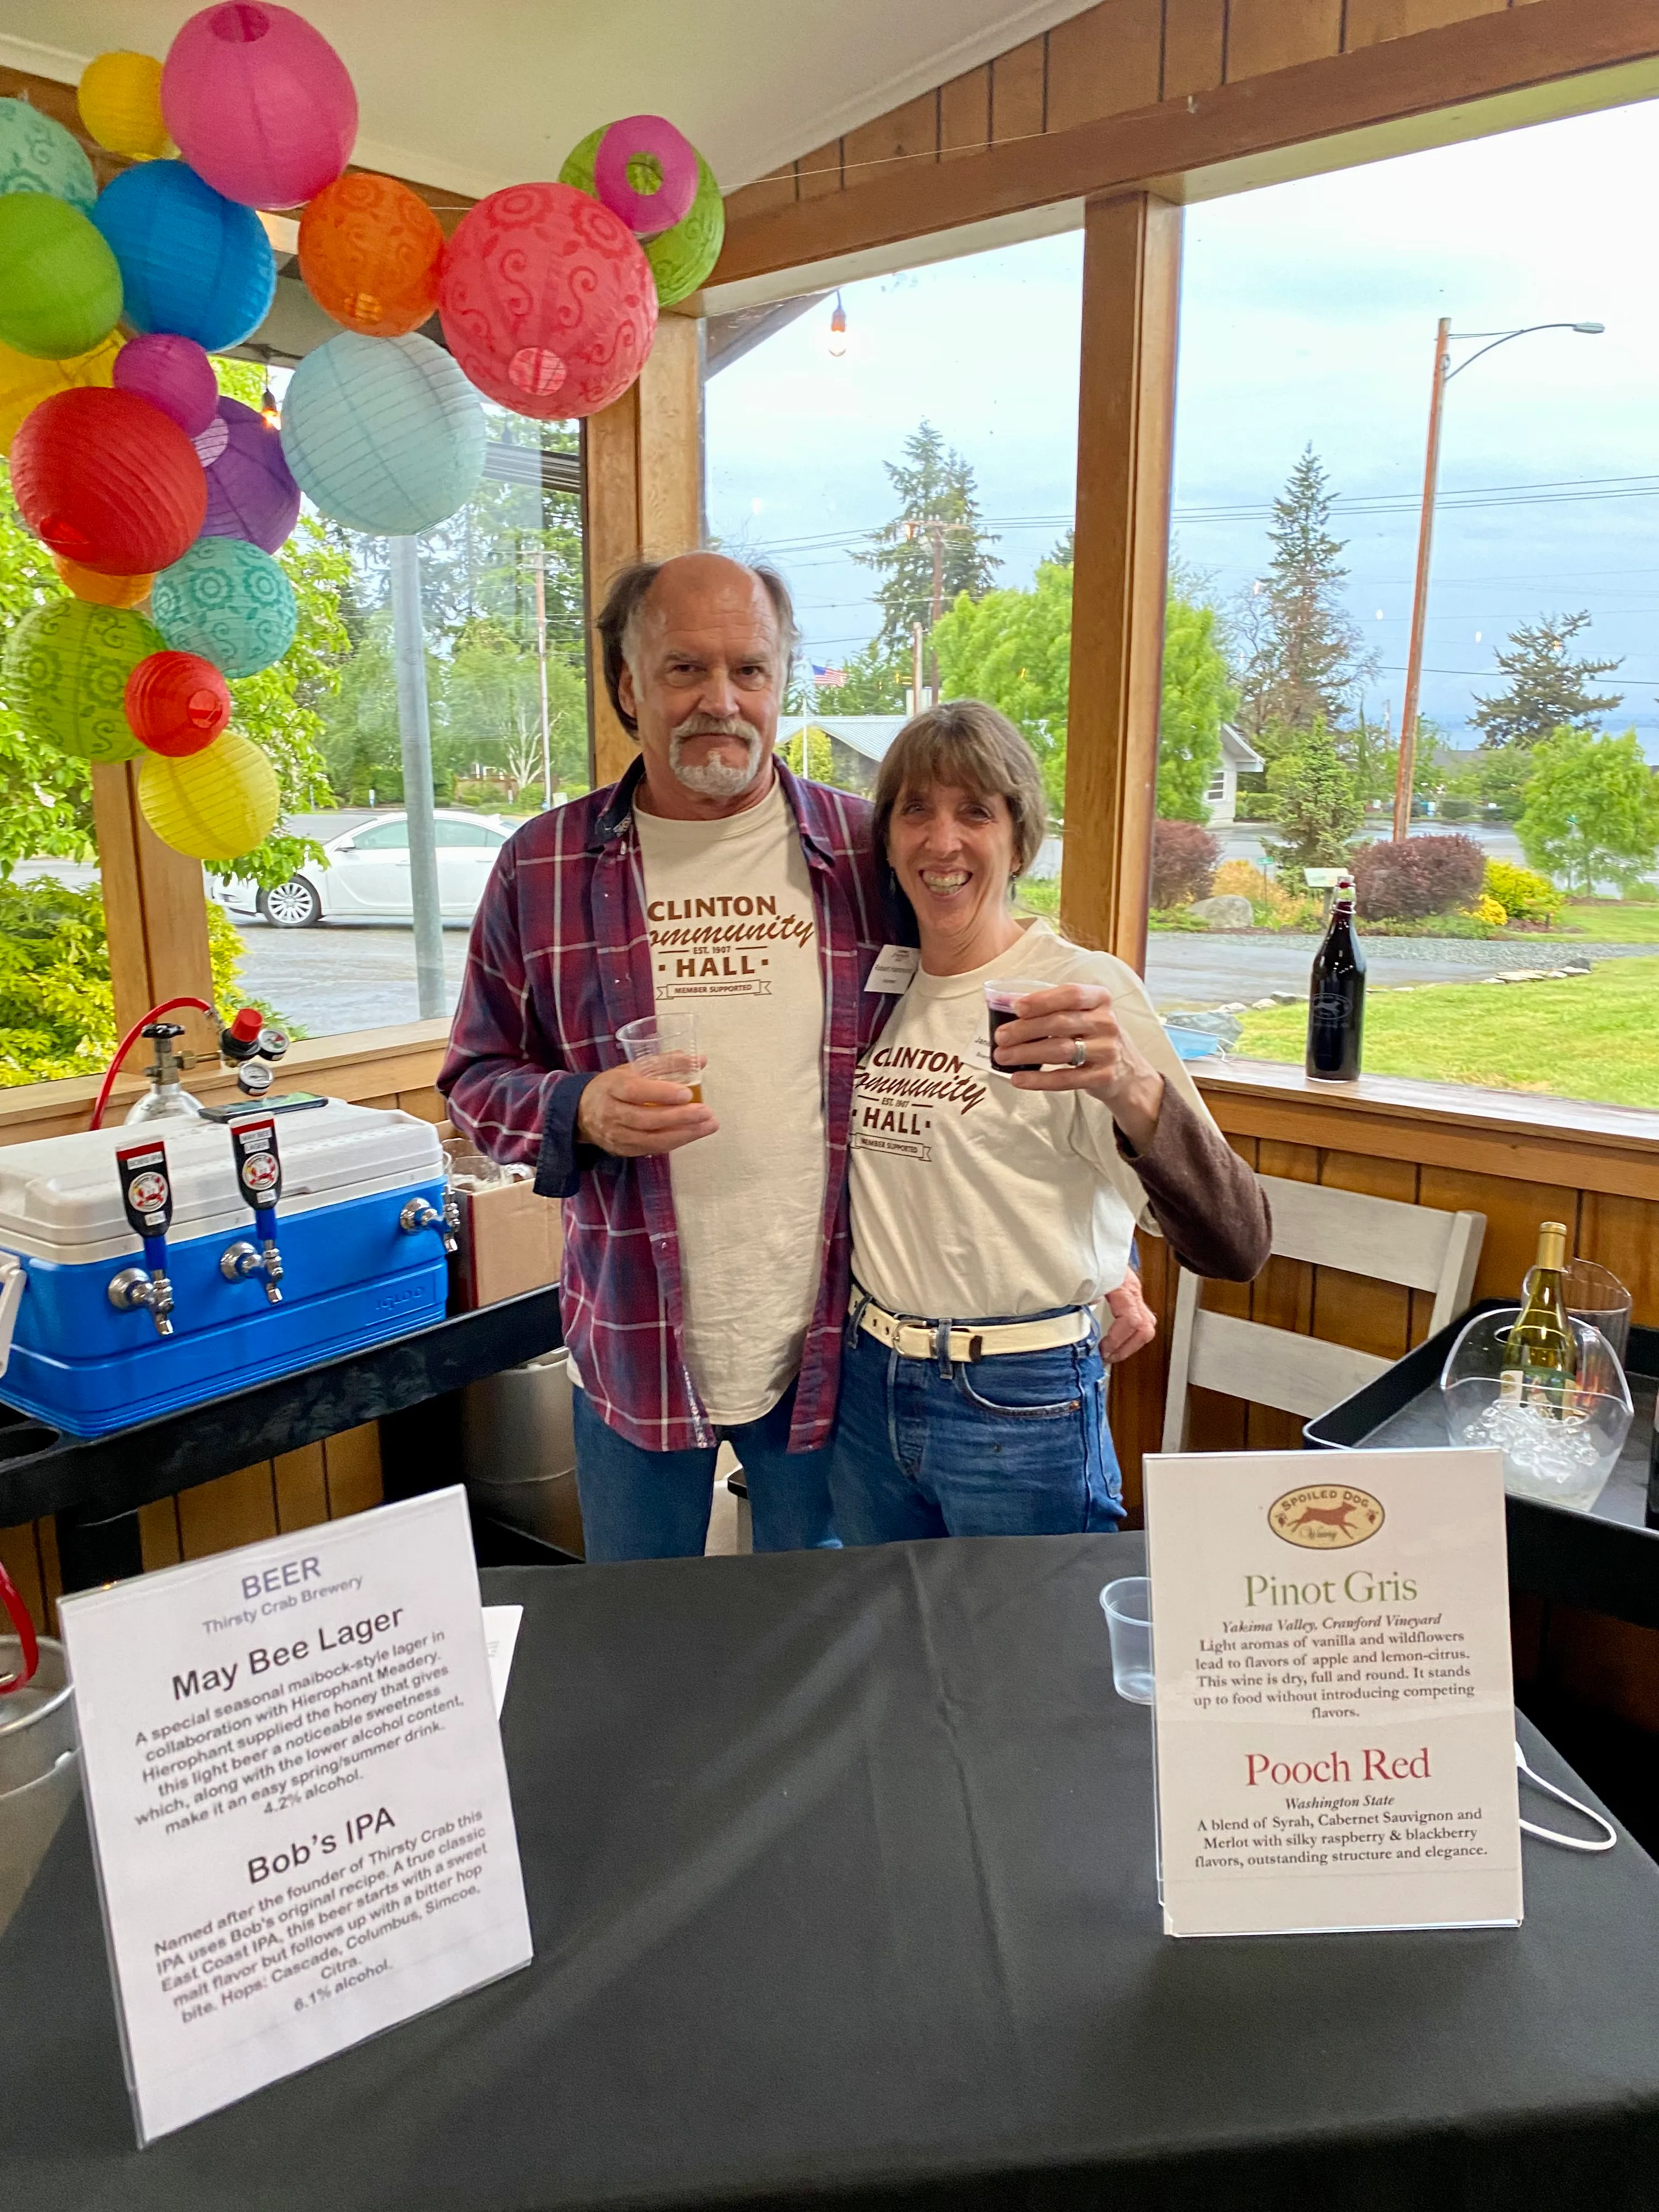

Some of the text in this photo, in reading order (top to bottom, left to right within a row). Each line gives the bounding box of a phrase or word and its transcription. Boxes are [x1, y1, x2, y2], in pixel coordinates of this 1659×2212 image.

[647, 895, 777, 922] CLINTON
[650, 913, 815, 949] ommunity
[713, 946, 732, 954] 1907
[676, 956, 755, 978] HALL
[709, 984, 753, 993] SUPPORTED
[873, 1047, 964, 1074] CLINTON
[854, 1066, 986, 1115] ommunity
[881, 1097, 894, 1106] EST.
[862, 1107, 921, 1136] HALL
[861, 1138, 918, 1153] MEMBER SUPPORTED
[375, 1286, 425, 1310] IGLOO
[1281, 1490, 1369, 1511] SPOILED DOG
[240, 1556, 321, 1601] BEER
[1244, 1570, 1418, 1607] Pinot Gris
[201, 1576, 363, 1635] Thirsty Crab Brewery
[1222, 1612, 1443, 1634] Yakima Valley, Crawford Vineyard
[171, 1607, 404, 1701] May Bee Lager
[1199, 1630, 1465, 1655] Light aromas of vanilla and wildflowers
[1195, 1647, 1471, 1671] lead to flavors of apple and lemon-citrus.
[134, 1631, 445, 1747] A special seasonal maibock-style lager in
[1196, 1664, 1471, 1688] This wine is dry, full and round. It stands
[145, 1651, 442, 1763] collaboration with Hierophant Meadery.
[1193, 1682, 1475, 1709] up to food without introducing competing
[142, 1666, 449, 1784] Hierophant supplied the honey that gives
[1311, 1706, 1361, 1719] flavors.
[157, 1686, 441, 1798] this light beer a noticeable sweetness
[134, 1695, 464, 1826] which, along with the lower alcohol content,
[1245, 1747, 1432, 1786] Pooch Red
[165, 1720, 445, 1835] make it an easy spring/summer drink.
[263, 1768, 364, 1815] 4.2% alcohol.
[1285, 1794, 1395, 1812] Washington State
[1198, 1807, 1482, 1832] A blend of Syrah, Cabernet Sauvignon and
[247, 1807, 396, 1884] Bob's IPA
[1204, 1826, 1477, 1850] Merlot with silky raspberry & blackberry
[1194, 1845, 1488, 1869] flavors, outstanding structure and elegance.
[154, 1811, 483, 1957] Named after the founder of Thirsty Crab this
[156, 1953, 186, 1976] IPA
[188, 1937, 227, 1963] uses
[229, 1916, 276, 1944] Bob's
[276, 1887, 336, 1923] original
[393, 1860, 405, 1875] A
[405, 1848, 436, 1869] true
[437, 1827, 486, 1855] classic
[270, 1946, 344, 1984] Cascade,
[345, 1910, 423, 1950] Columbus,
[425, 1885, 481, 1915] Simcoe,
[320, 1956, 362, 1980] Citra.
[293, 1958, 393, 2012] 6.1% alcohol.
